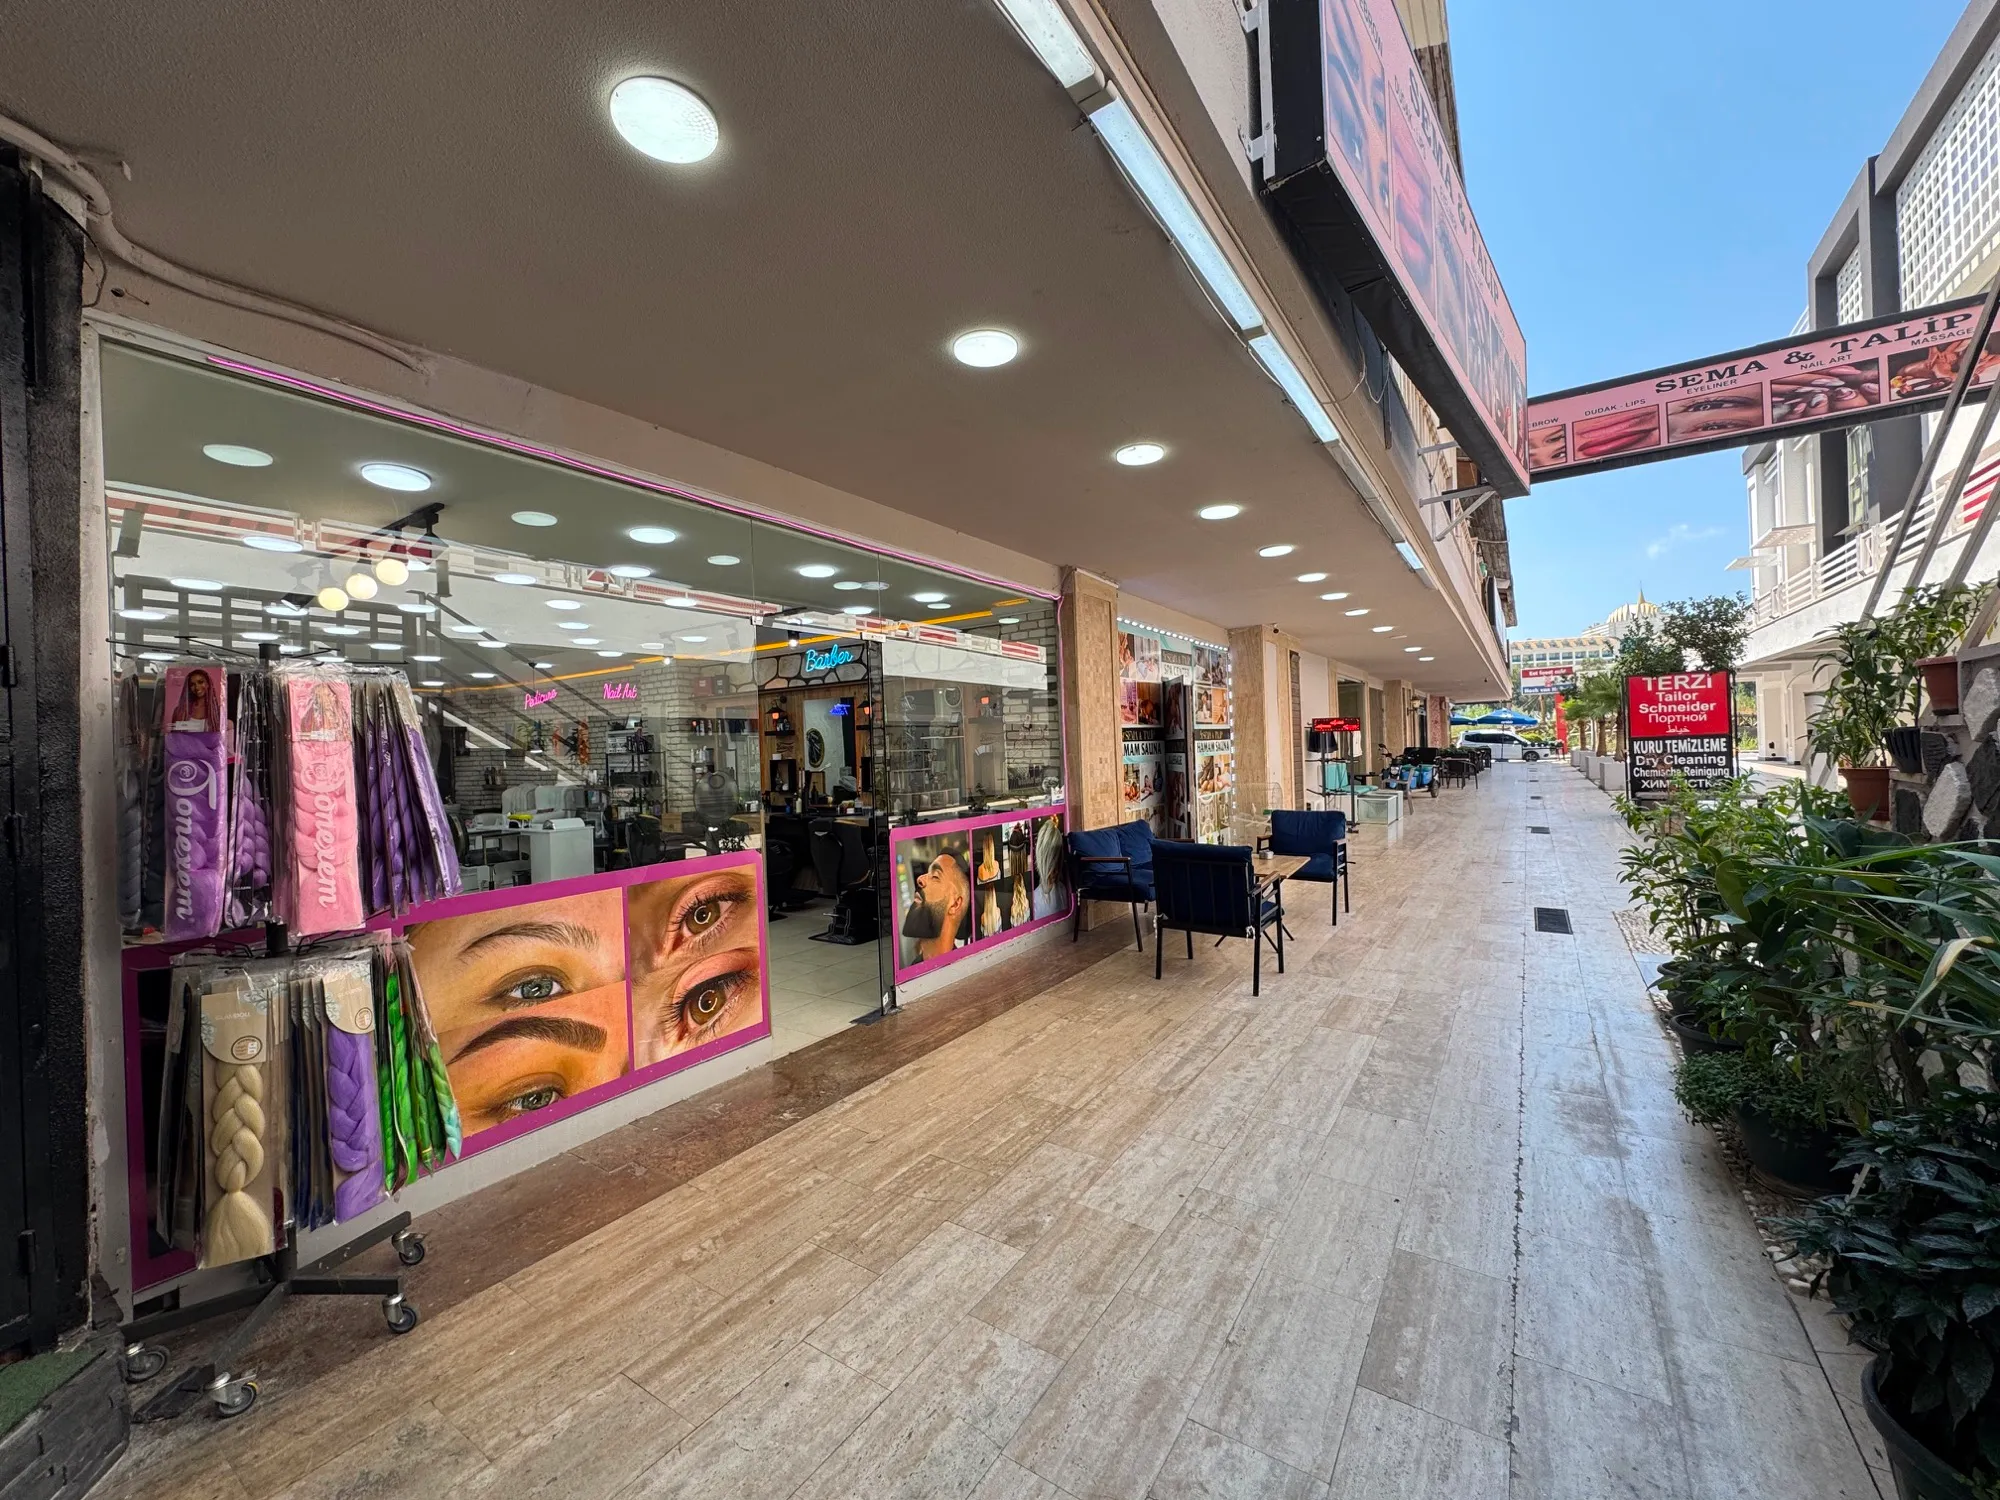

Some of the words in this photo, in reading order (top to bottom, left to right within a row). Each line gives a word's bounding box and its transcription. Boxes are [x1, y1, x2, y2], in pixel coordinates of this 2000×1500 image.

[1409, 67, 1455, 205] SEMA
[1911, 327, 1975, 347] MASSAGE
[1655, 360, 1768, 394] SEMA
[1783, 351, 1816, 365] &
[1830, 313, 1973, 354] TALİP
[1800, 359, 1825, 371] NAIL
[1829, 354, 1853, 364] ART
[1686, 378, 1738, 395] EYELINER
[1584, 404, 1617, 417] DUDAK
[1625, 398, 1646, 409] LIPS
[1528, 417, 1559, 429] BROW
[805, 643, 854, 673] Barber
[603, 682, 622, 699] Nail
[622, 683, 638, 699] Art
[1656, 691, 1699, 702] Tailor
[524, 688, 558, 711] Pedicure
[1639, 701, 1717, 714] Schneider
[1649, 712, 1707, 724] Портной
[1141, 742, 1162, 755] SAUNA
[1633, 740, 1663, 754] KURU
[1635, 755, 1659, 768] Dry
[1664, 754, 1726, 766] Cleaning
[1633, 767, 1682, 778] Chemische
[1684, 766, 1730, 778] Reinigung
